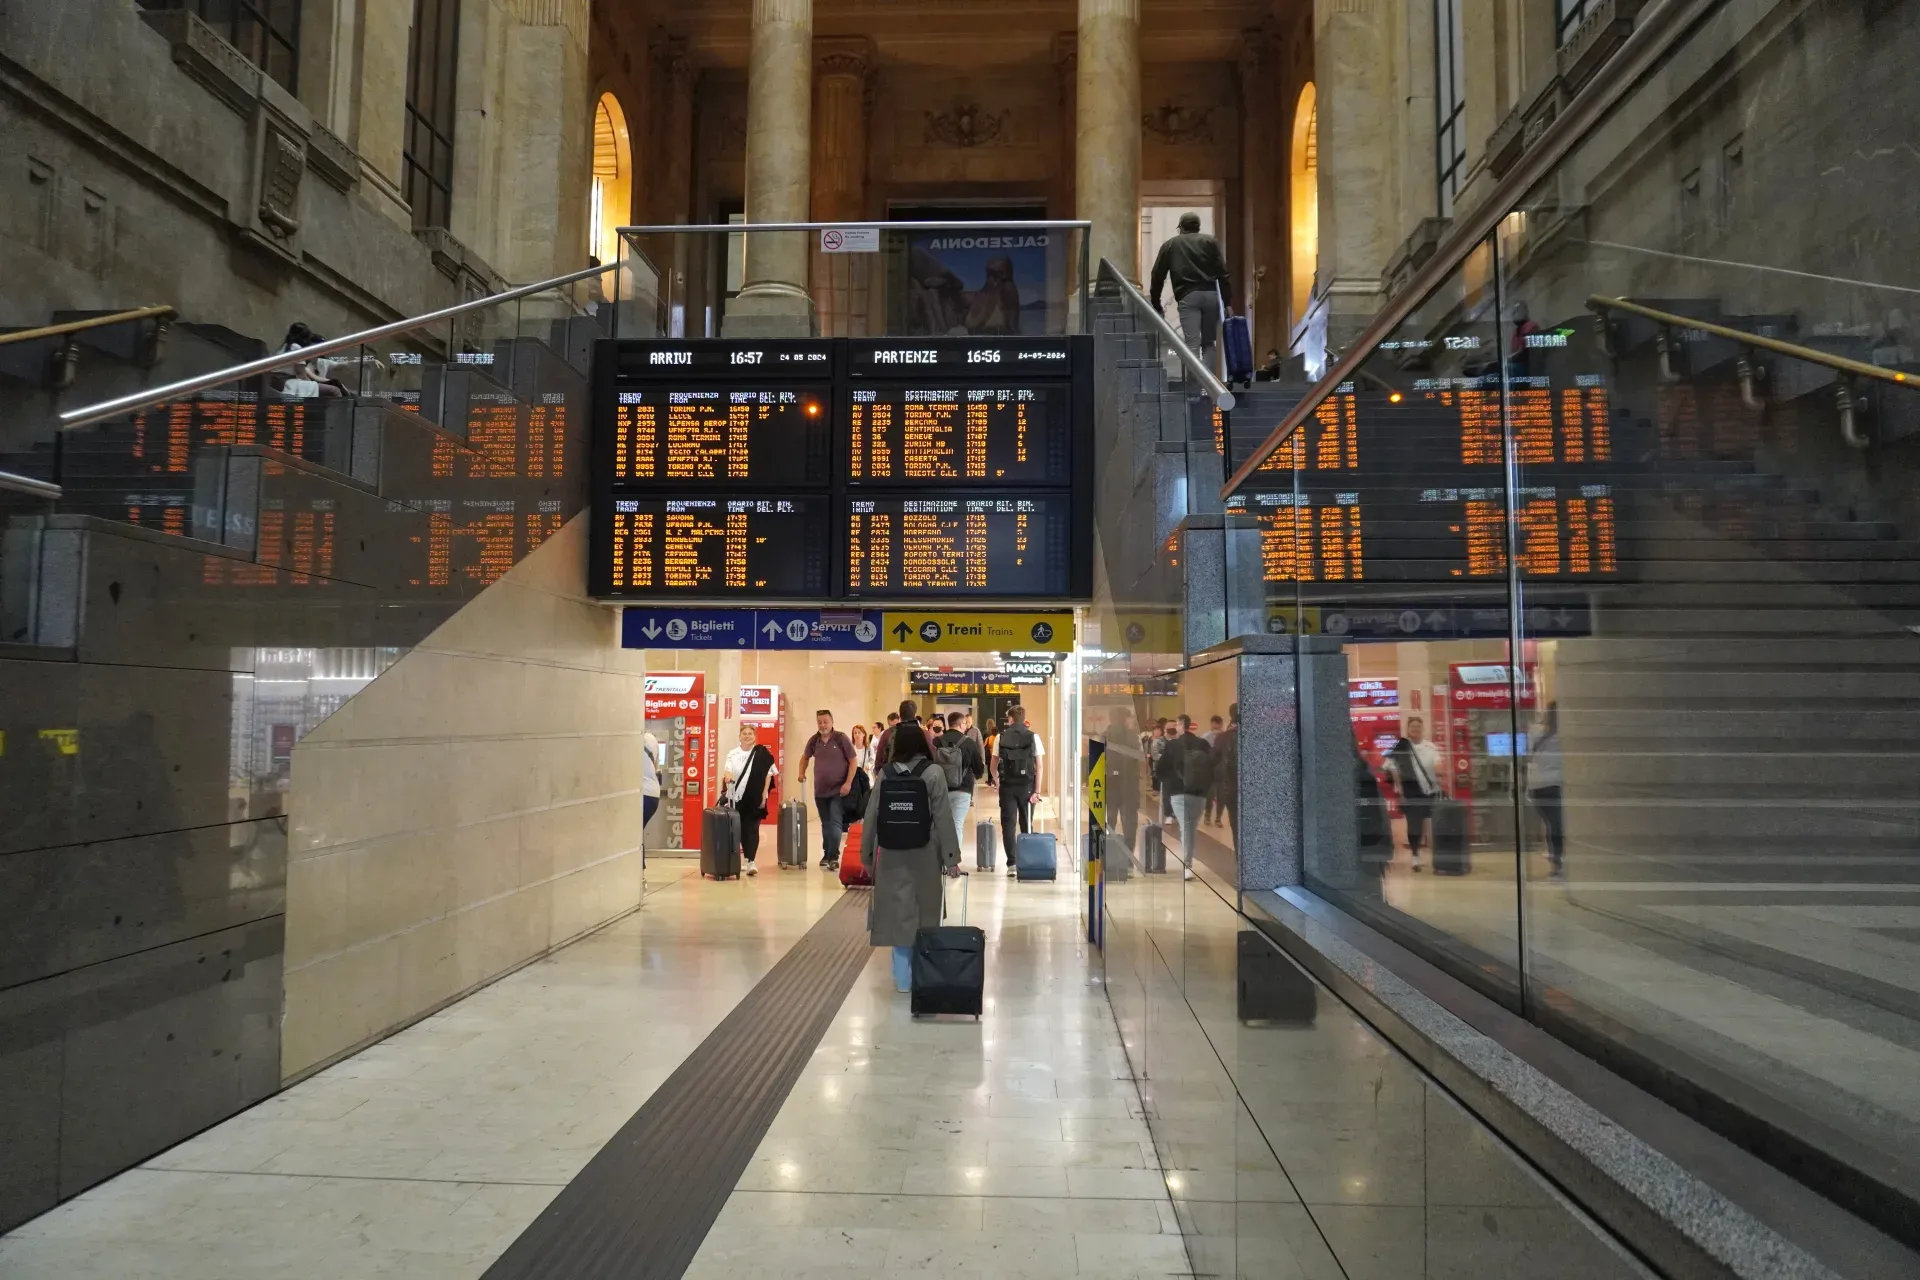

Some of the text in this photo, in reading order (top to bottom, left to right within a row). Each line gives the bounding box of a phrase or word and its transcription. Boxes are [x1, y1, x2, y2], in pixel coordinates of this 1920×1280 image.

[649, 352, 693, 365] ARRIVI
[730, 351, 764, 364] 16:57
[874, 350, 938, 364] PARTENZE
[967, 350, 1001, 363] 16:56
[691, 620, 735, 633] Biglietti
[811, 620, 851, 632] Servizi
[947, 622, 1014, 636] Treni Trains
[691, 633, 713, 641] Tickets
[1006, 663, 1053, 673] MANGO
[645, 700, 676, 709] Biglietti
[666, 716, 686, 849] Self Service
[1092, 778, 1103, 809] ATM
